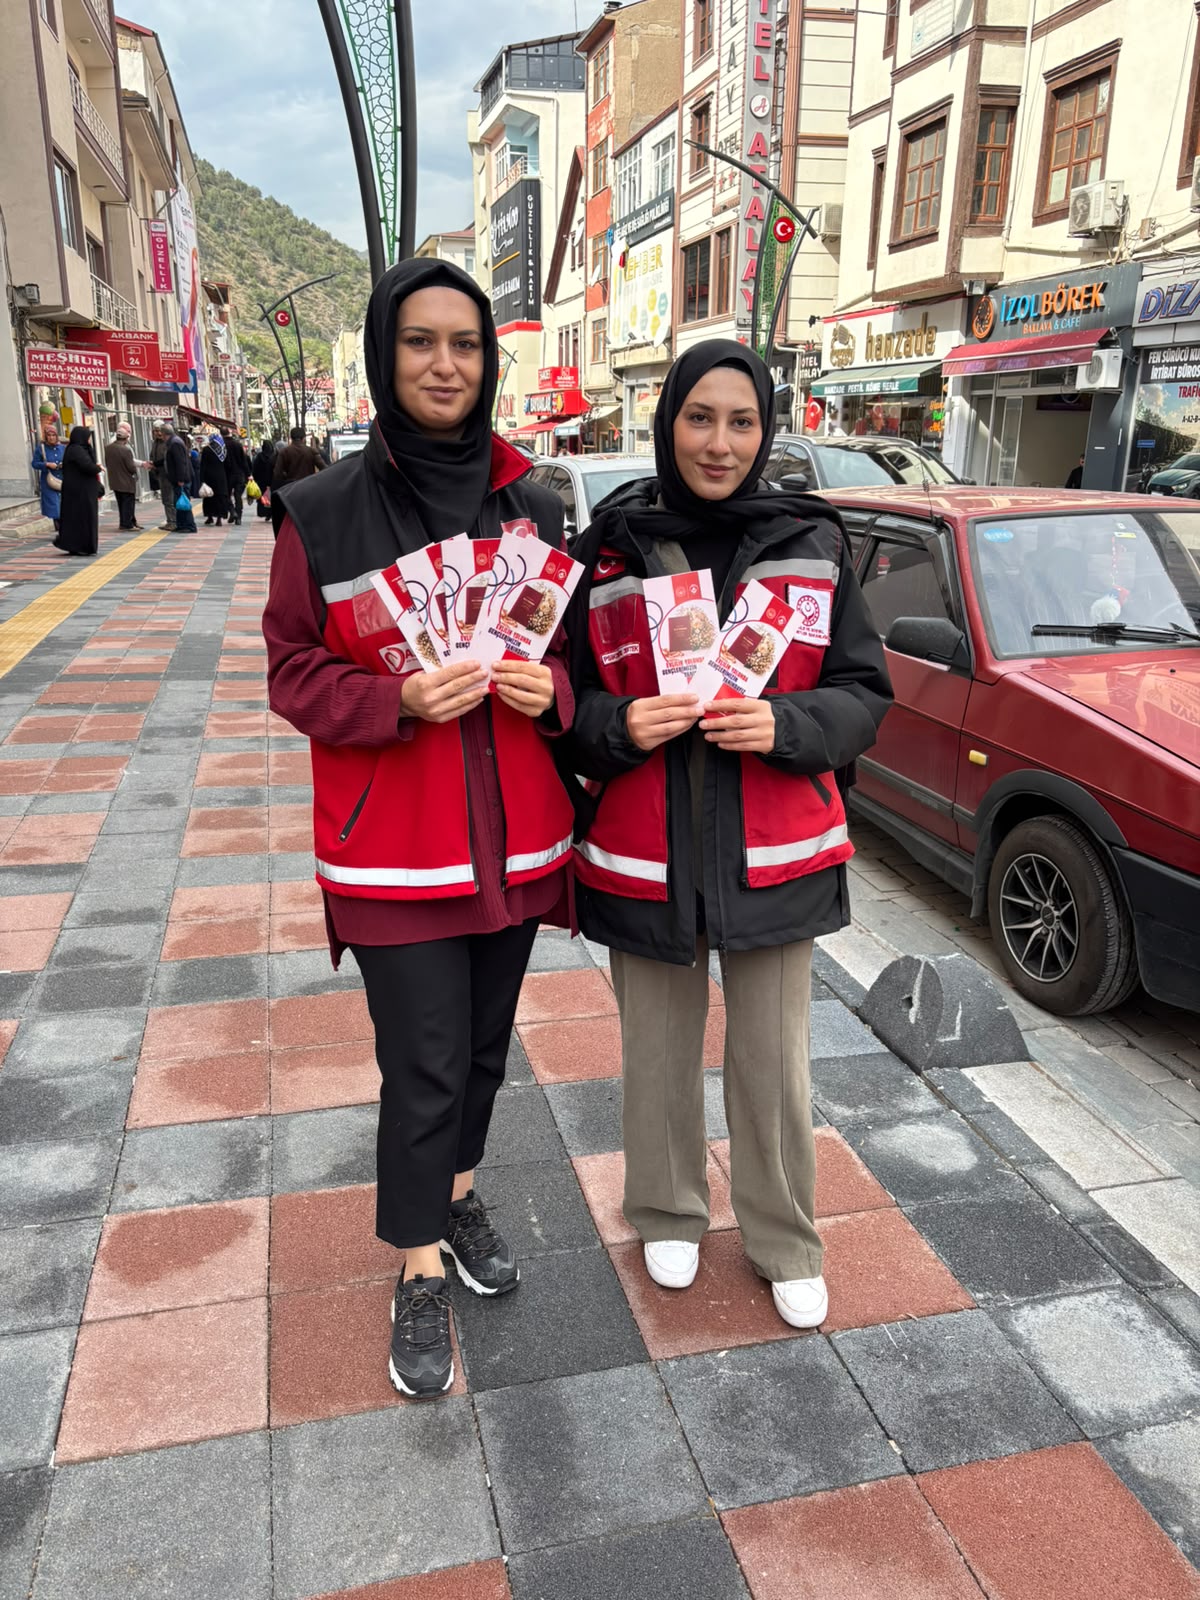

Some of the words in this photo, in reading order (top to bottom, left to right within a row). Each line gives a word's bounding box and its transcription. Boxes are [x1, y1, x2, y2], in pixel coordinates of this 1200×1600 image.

[740, 132, 769, 312] ATALAY
[1022, 321, 1052, 334] BAKLAVA
[1053, 321, 1060, 330] &
[111, 332, 154, 341] AKBANK
[865, 312, 937, 362] hanzade
[31, 352, 105, 367] MEŞHUR
[129, 357, 140, 366] 24
[1148, 351, 1162, 364] FEN
[1161, 347, 1189, 363] SÜRÜCÜ
[69, 373, 107, 383] SALONU
[164, 371, 173, 379] 24
[1150, 365, 1177, 380] İRTİBAT
